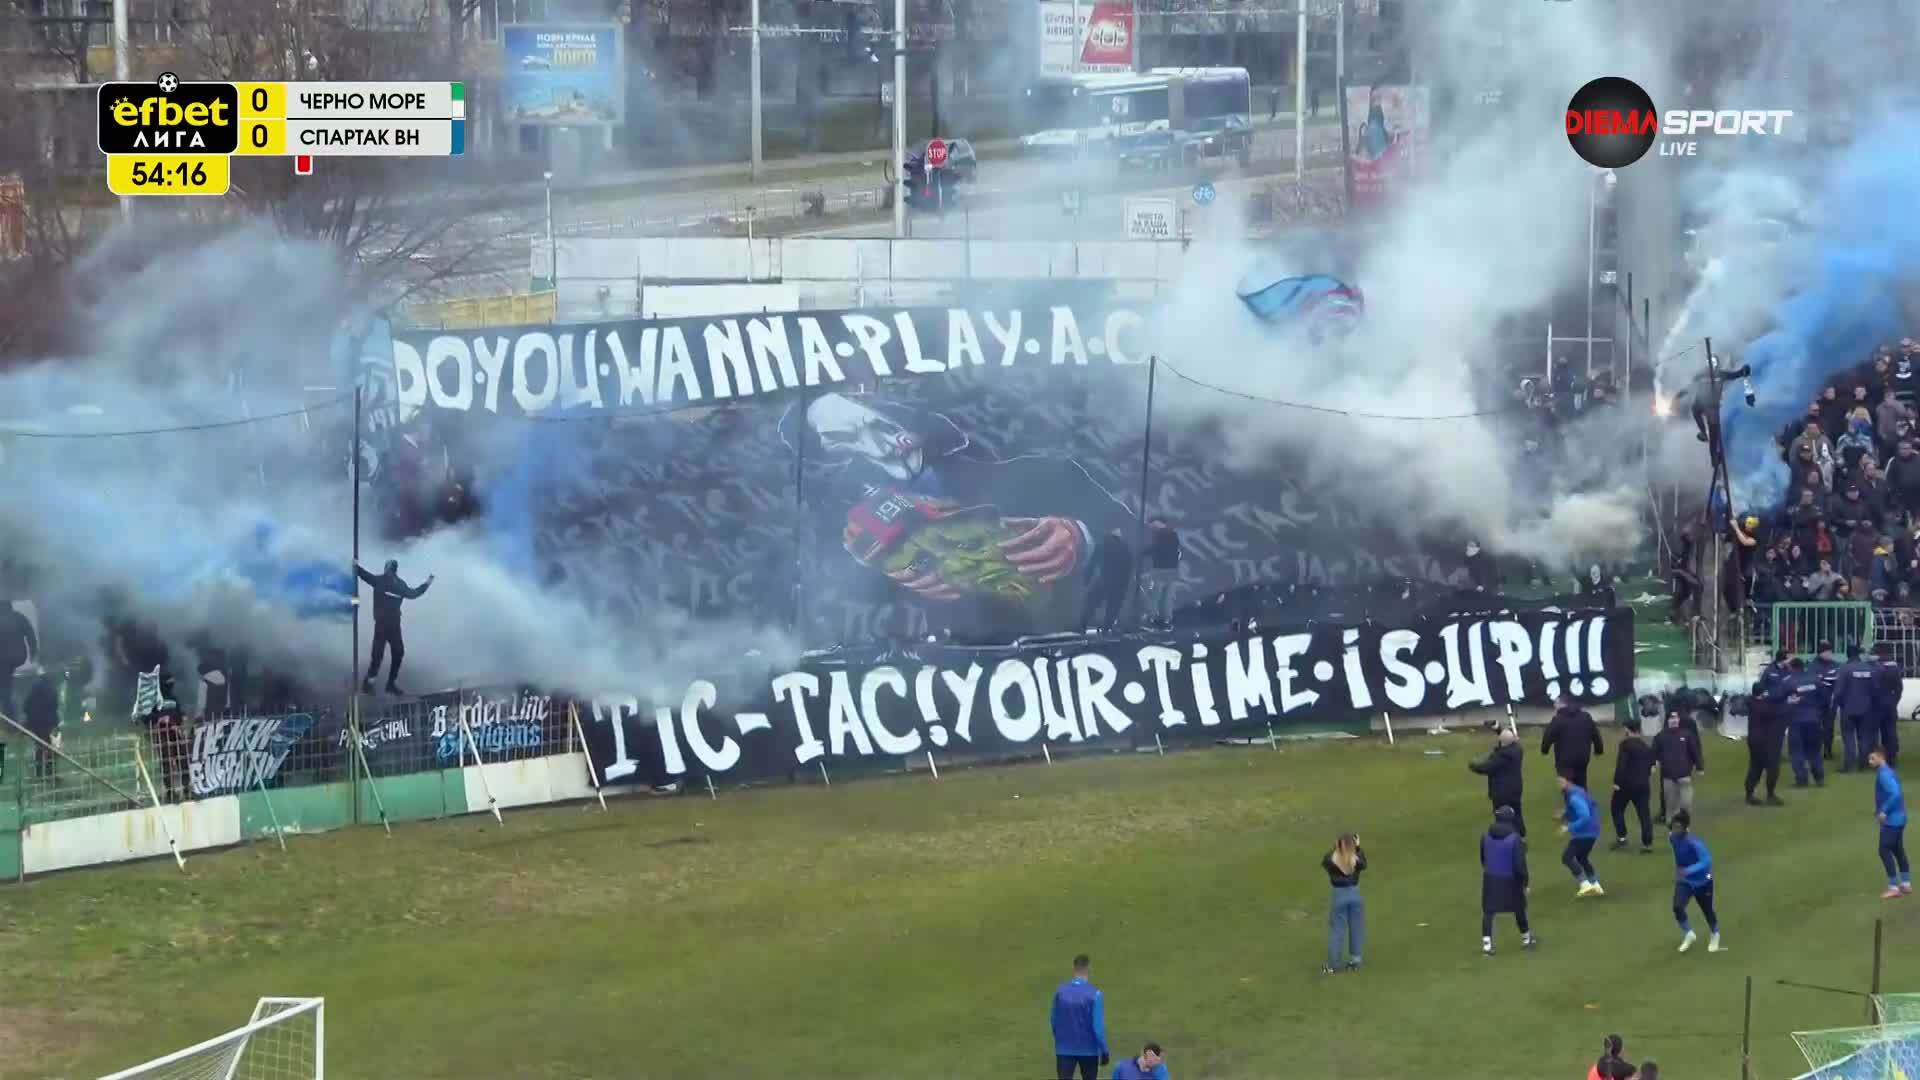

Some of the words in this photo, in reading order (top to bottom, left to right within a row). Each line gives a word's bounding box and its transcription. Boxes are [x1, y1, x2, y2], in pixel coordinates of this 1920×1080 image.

[928, 147, 947, 160] STOP
[392, 336, 473, 418] DO
[473, 329, 604, 413] YOU
[606, 314, 846, 407] WANNA
[840, 307, 1023, 377] PLAY
[1049, 305, 1089, 366] A
[431, 691, 505, 737] Brder
[941, 653, 1133, 743] YOUR
[1438, 616, 1610, 710] UP!!!
